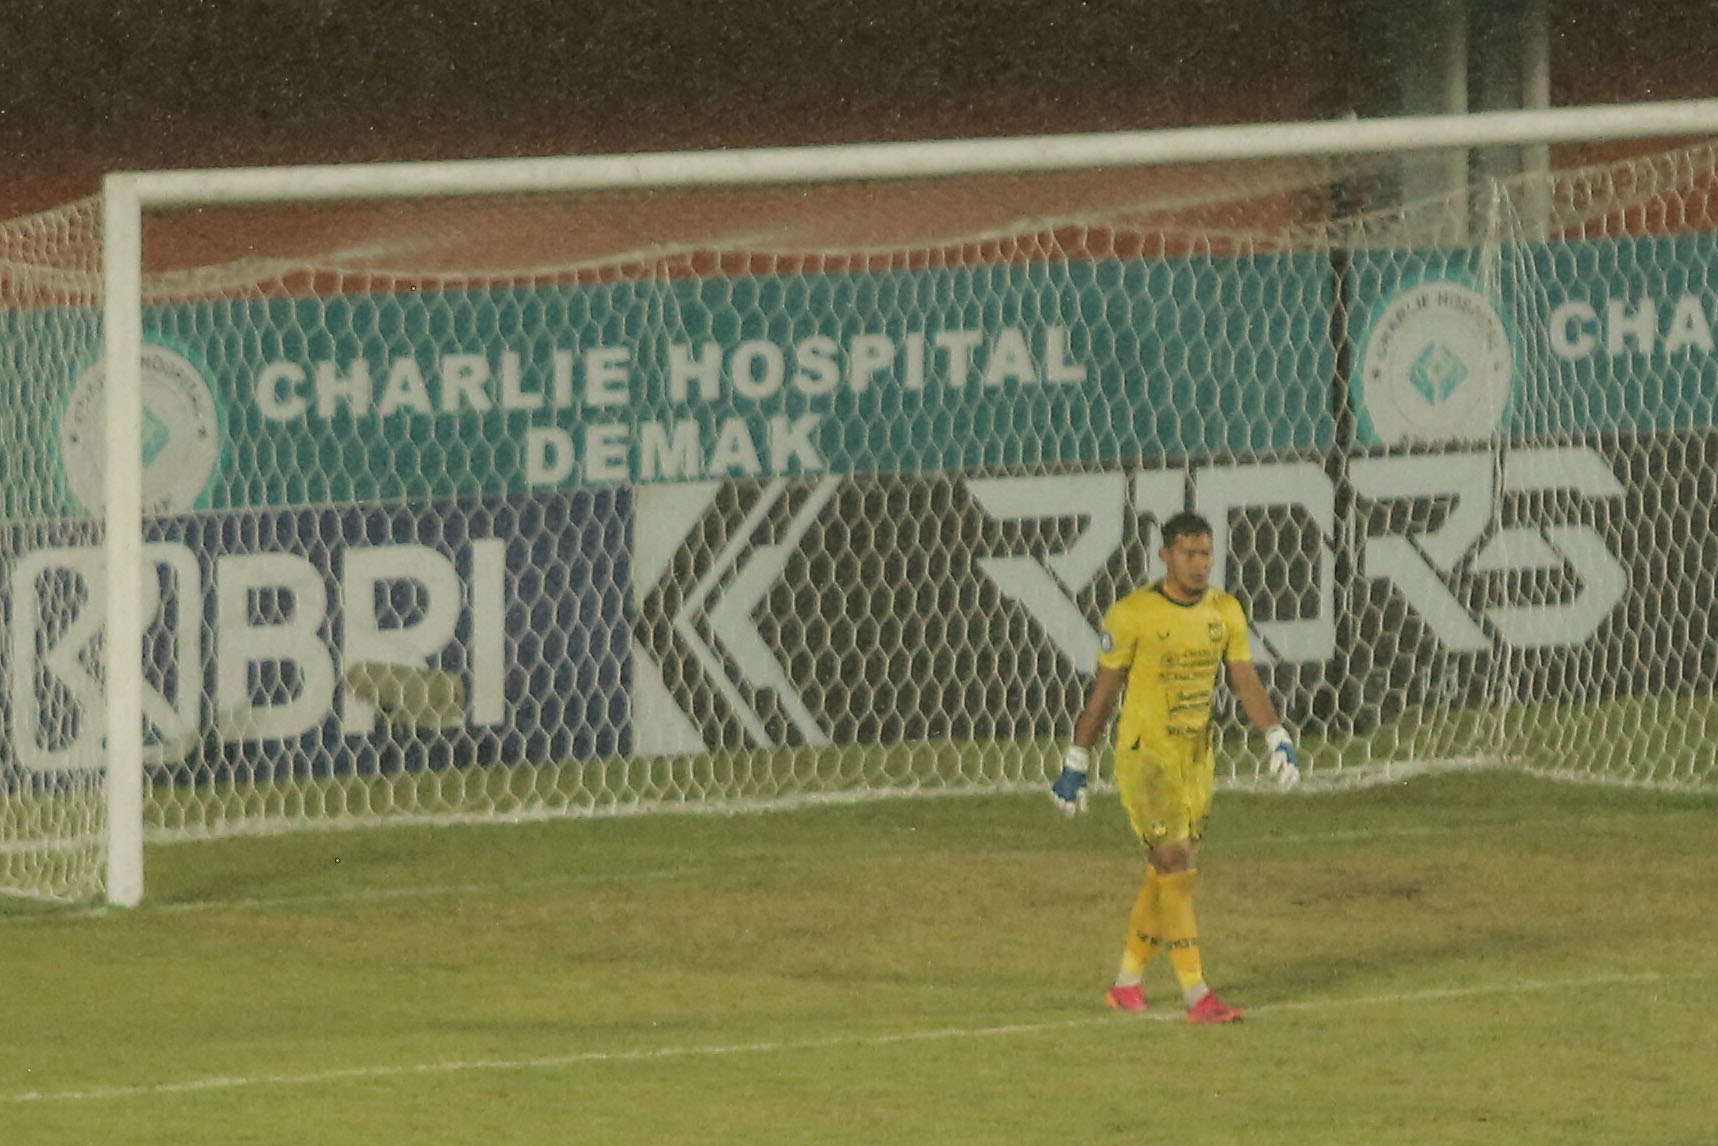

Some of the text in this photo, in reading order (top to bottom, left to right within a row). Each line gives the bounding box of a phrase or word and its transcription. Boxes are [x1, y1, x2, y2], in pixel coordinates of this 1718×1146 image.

[255, 346, 631, 421] CHARLIE
[669, 325, 1087, 400] HOSPITAL
[526, 414, 825, 486] DEMAK
[214, 537, 506, 743] BRI
